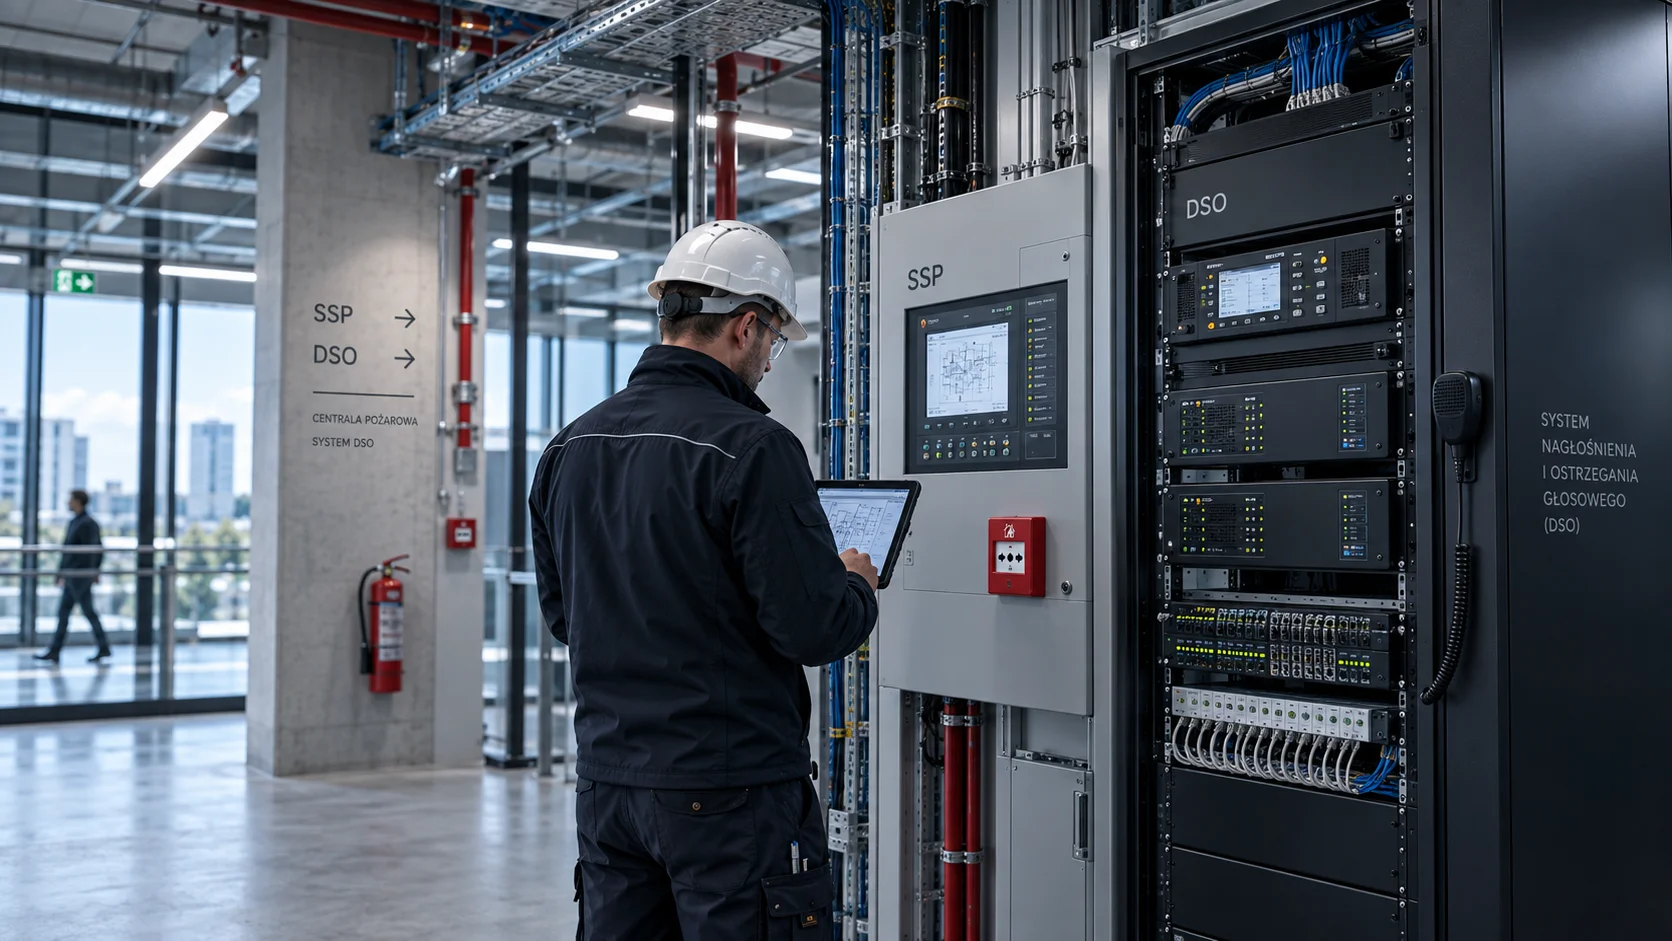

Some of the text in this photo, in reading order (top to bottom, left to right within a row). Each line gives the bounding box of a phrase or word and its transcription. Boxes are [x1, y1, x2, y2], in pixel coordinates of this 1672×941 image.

[1187, 193, 1227, 220] DSO
[907, 264, 944, 291] SSP
[313, 303, 353, 323] SSP
[313, 344, 358, 366] DSO
[312, 413, 419, 426] CENTRALA POŻAROWA
[1541, 412, 1590, 429] SYSTEM
[312, 436, 375, 448] SYSTEM DSO
[1542, 438, 1637, 458] NAGŁOŚNIENIA
[1543, 465, 1639, 483] I OSTRZEGANIA
[1543, 491, 1626, 508] GŁOSOWEGO
[1544, 517, 1580, 535] (DSO)
